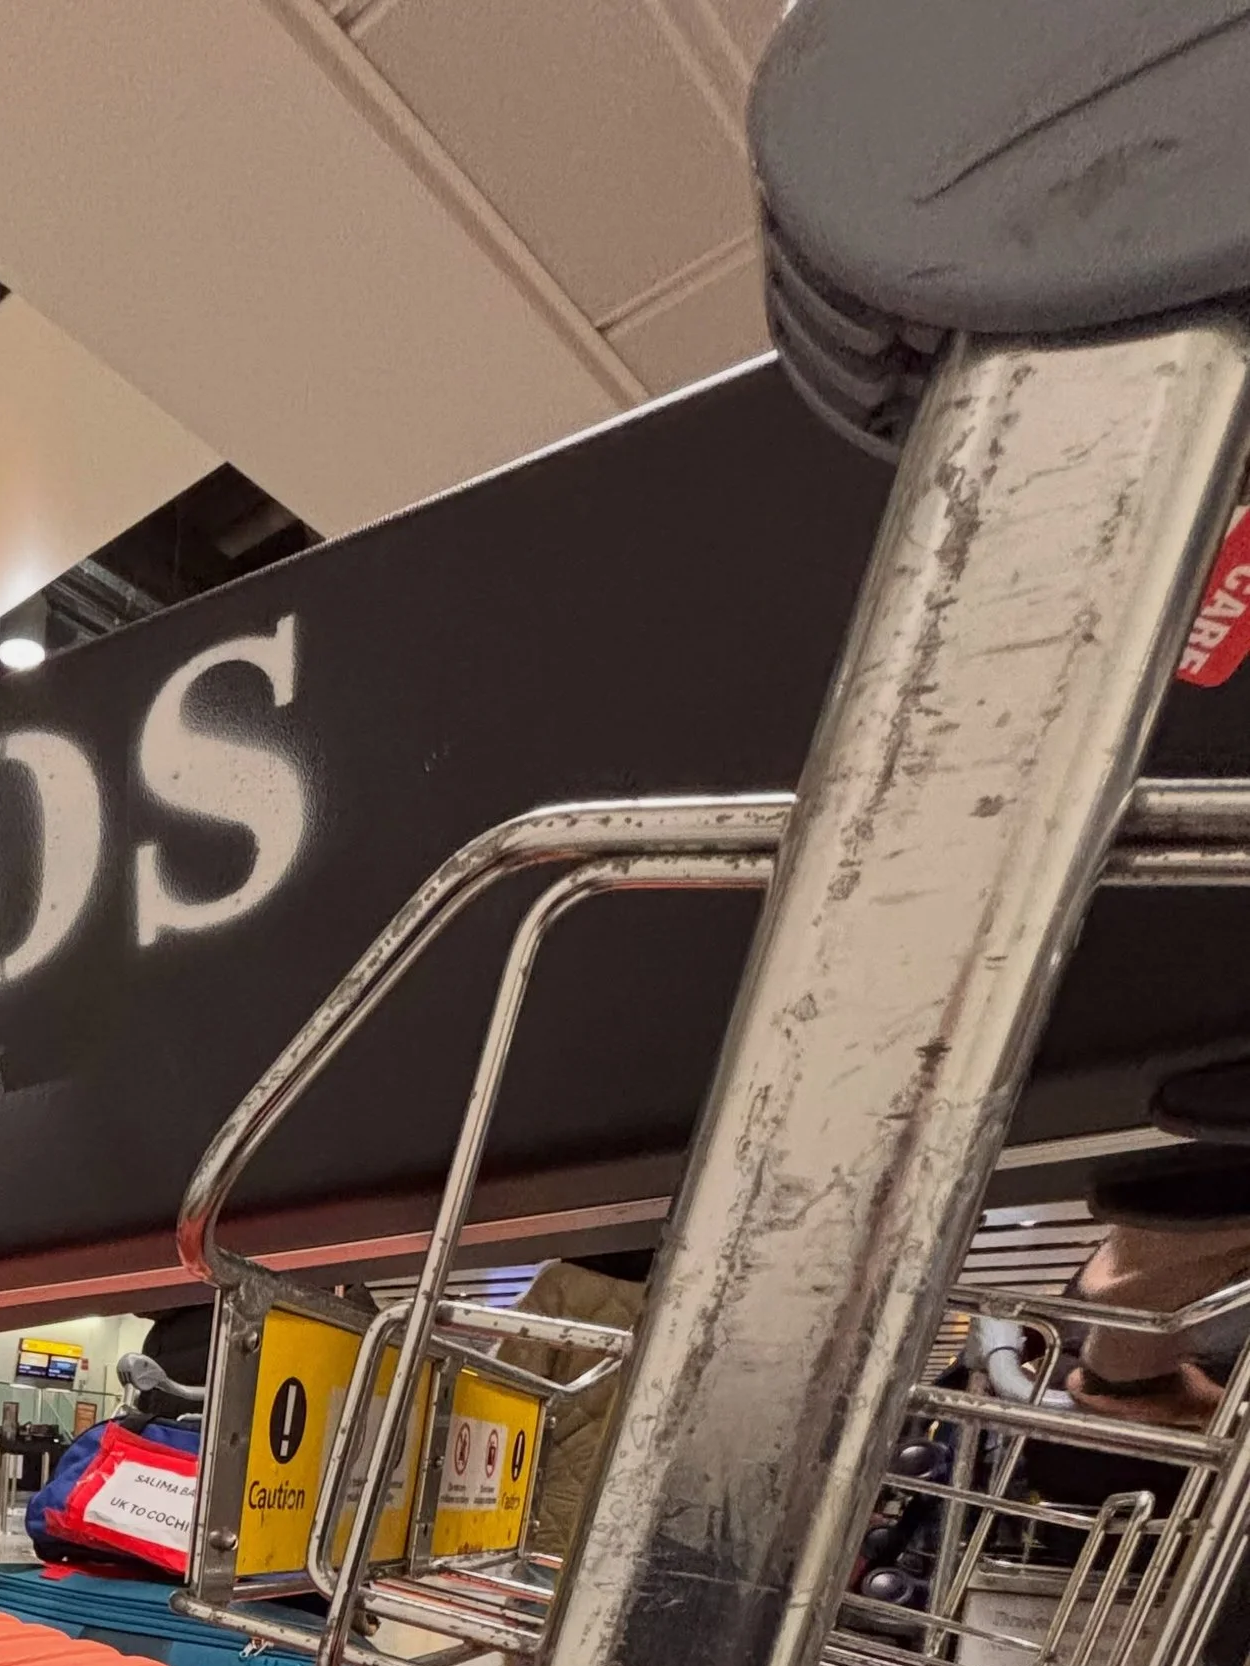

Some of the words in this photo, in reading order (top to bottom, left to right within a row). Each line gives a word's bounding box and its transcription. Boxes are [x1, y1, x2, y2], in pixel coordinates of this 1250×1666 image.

[134, 1474, 179, 1494] SALIMA
[248, 1480, 306, 1511] Caution
[110, 1496, 129, 1511] UK
[129, 1503, 146, 1517] TO
